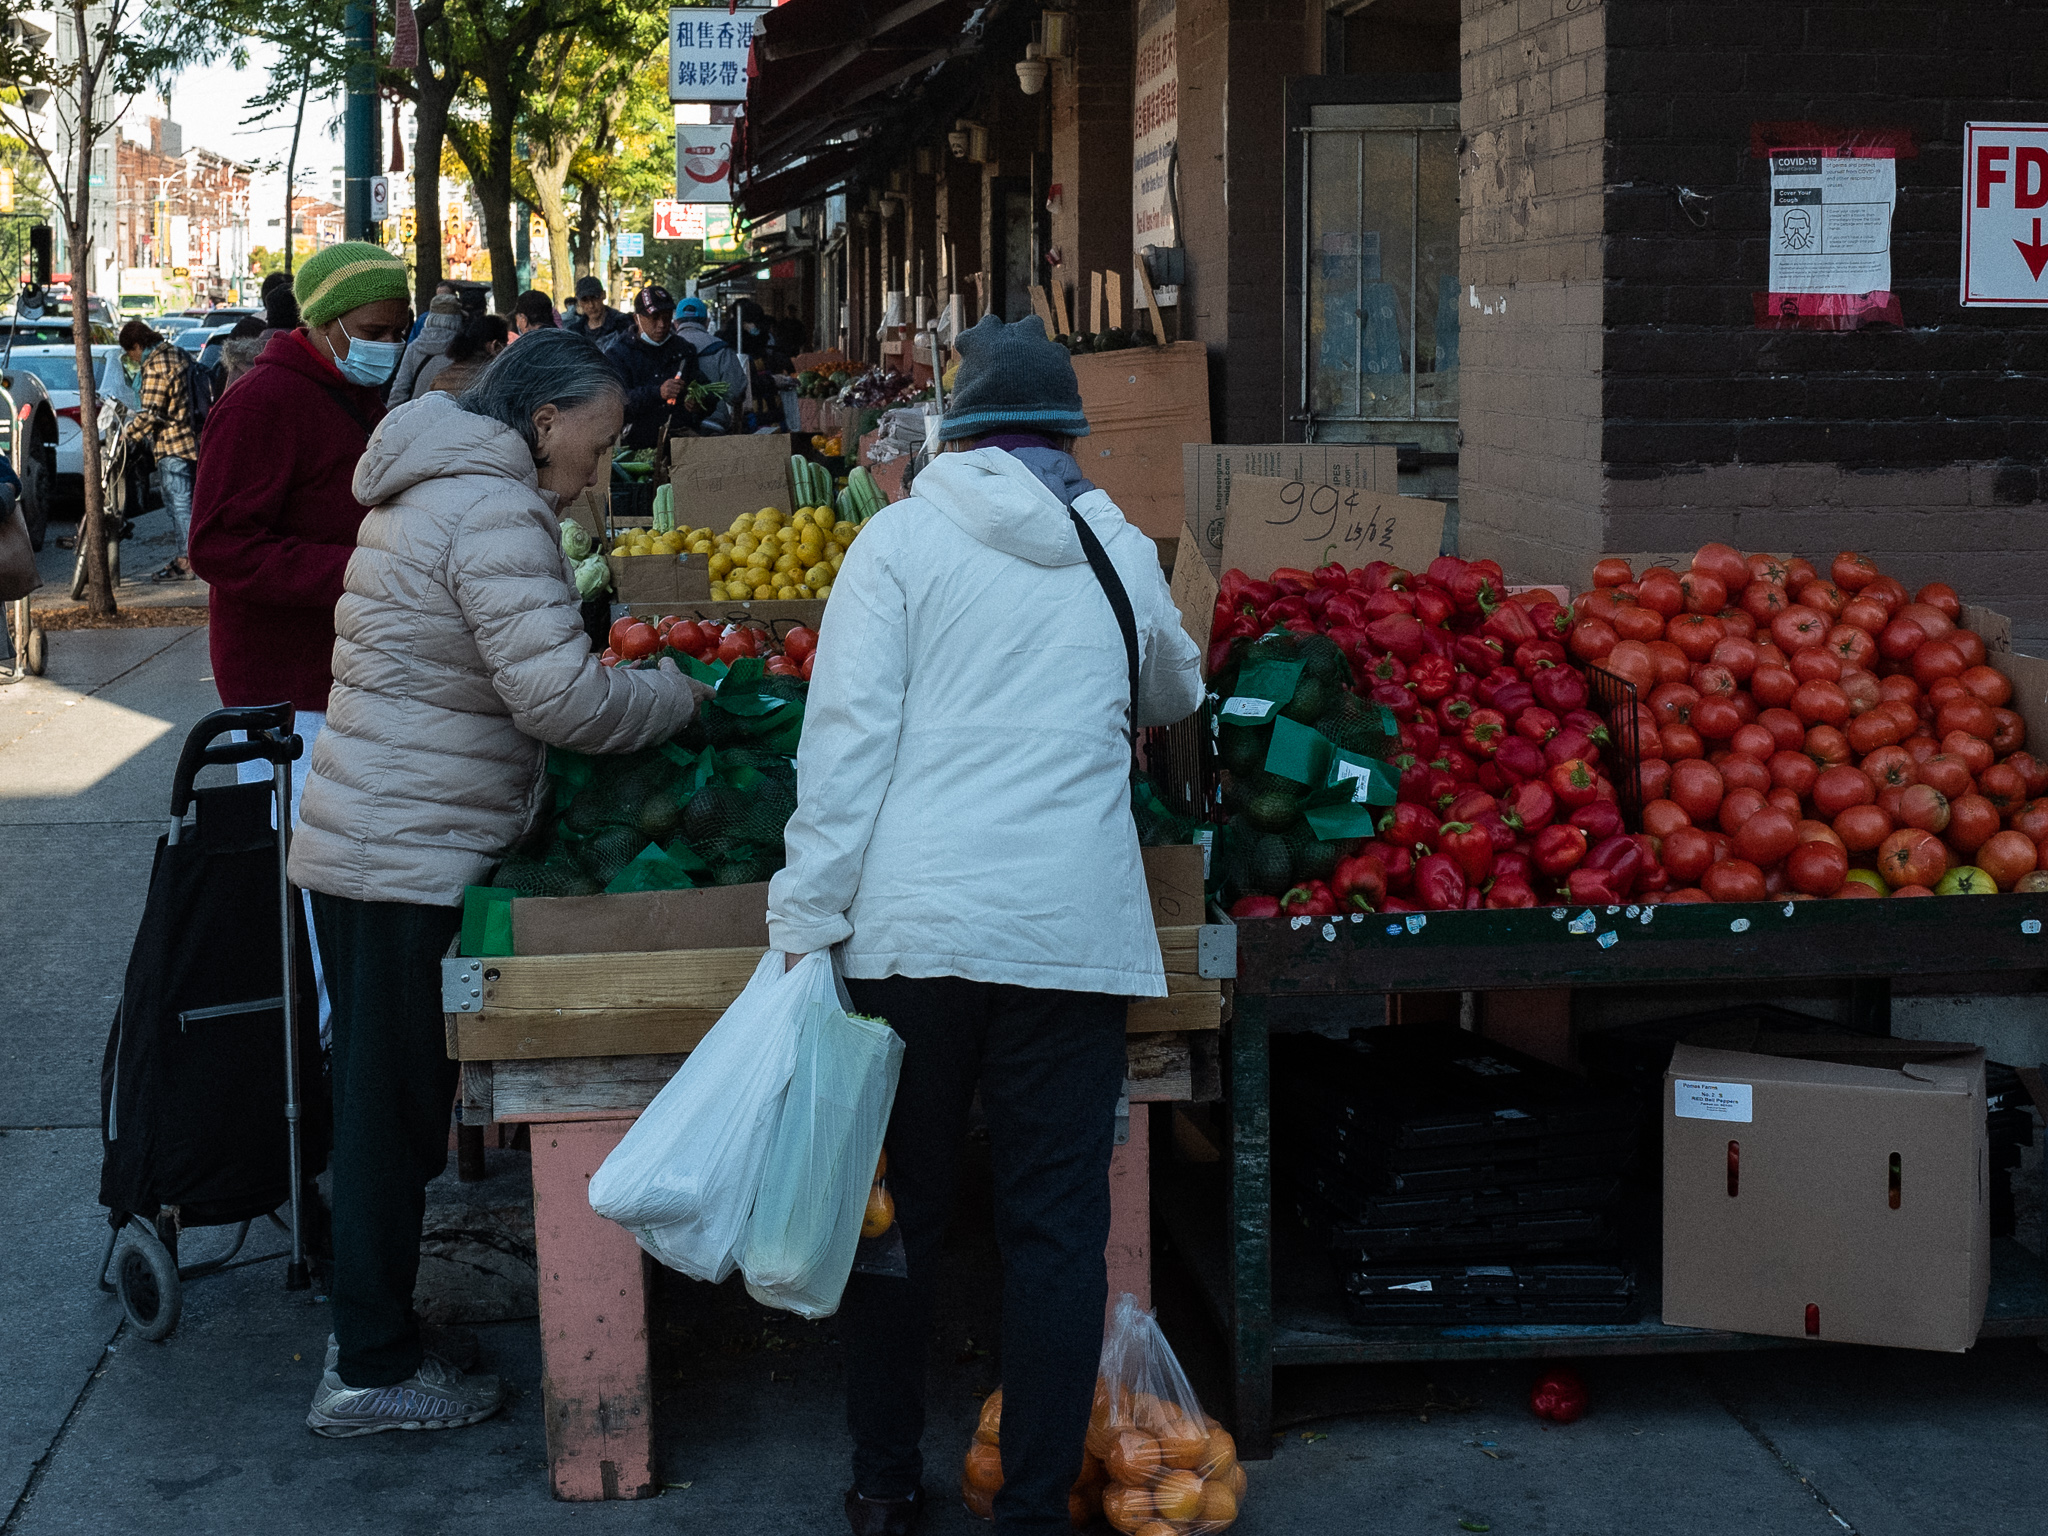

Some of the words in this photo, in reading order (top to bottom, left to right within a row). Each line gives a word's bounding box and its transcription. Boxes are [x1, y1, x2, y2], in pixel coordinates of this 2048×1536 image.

[676, 21, 754, 49] 租售香港
[1778, 157, 1817, 167] COVID-19
